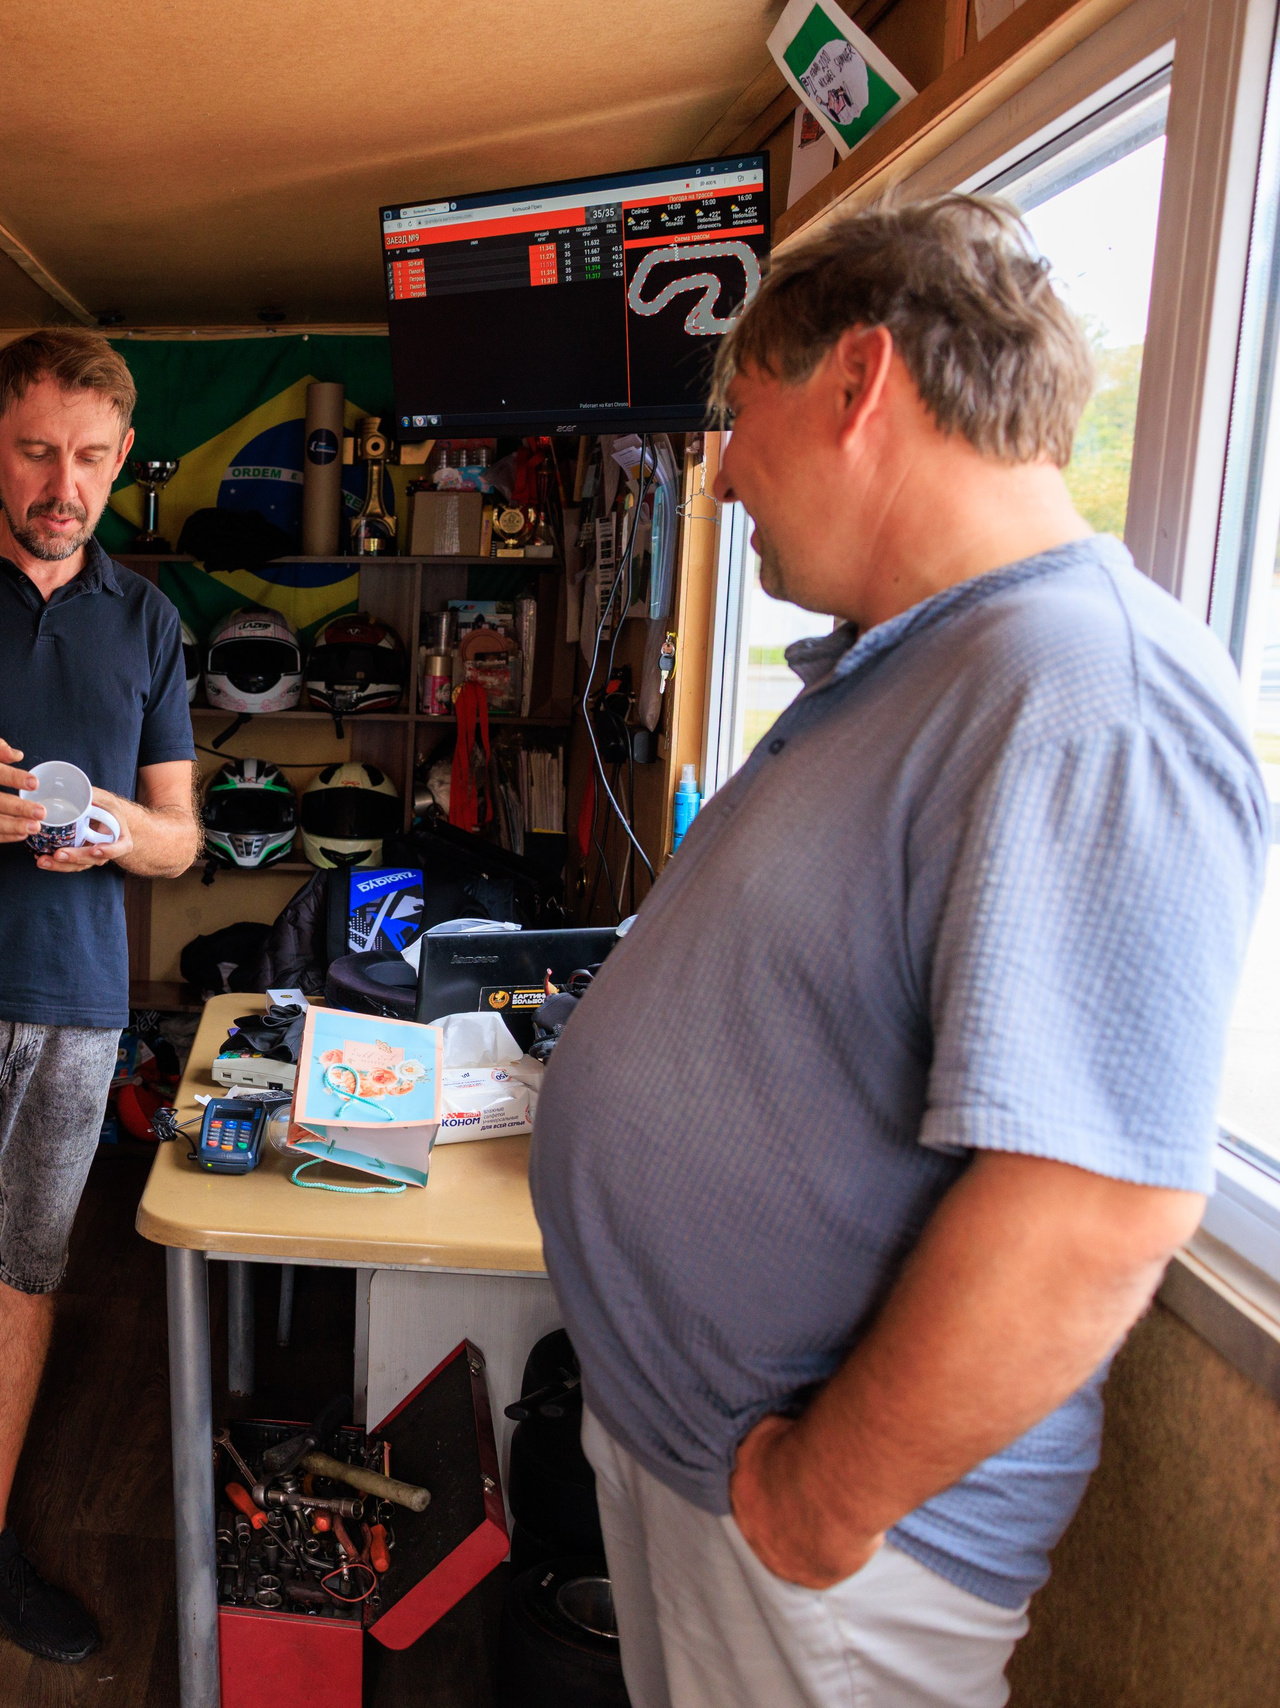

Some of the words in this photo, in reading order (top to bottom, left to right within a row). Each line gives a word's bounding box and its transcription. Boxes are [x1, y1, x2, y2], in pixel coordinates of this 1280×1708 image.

[592, 208, 614, 218] 35/35
[732, 218, 758, 226] облачность
[386, 235, 407, 245] ЗАЕЗД
[691, 233, 710, 241] трассы
[556, 424, 577, 433] acer
[232, 468, 282, 479] ORDEM
[451, 952, 499, 964] lenovo
[442, 1117, 480, 1127] КОНОМ
